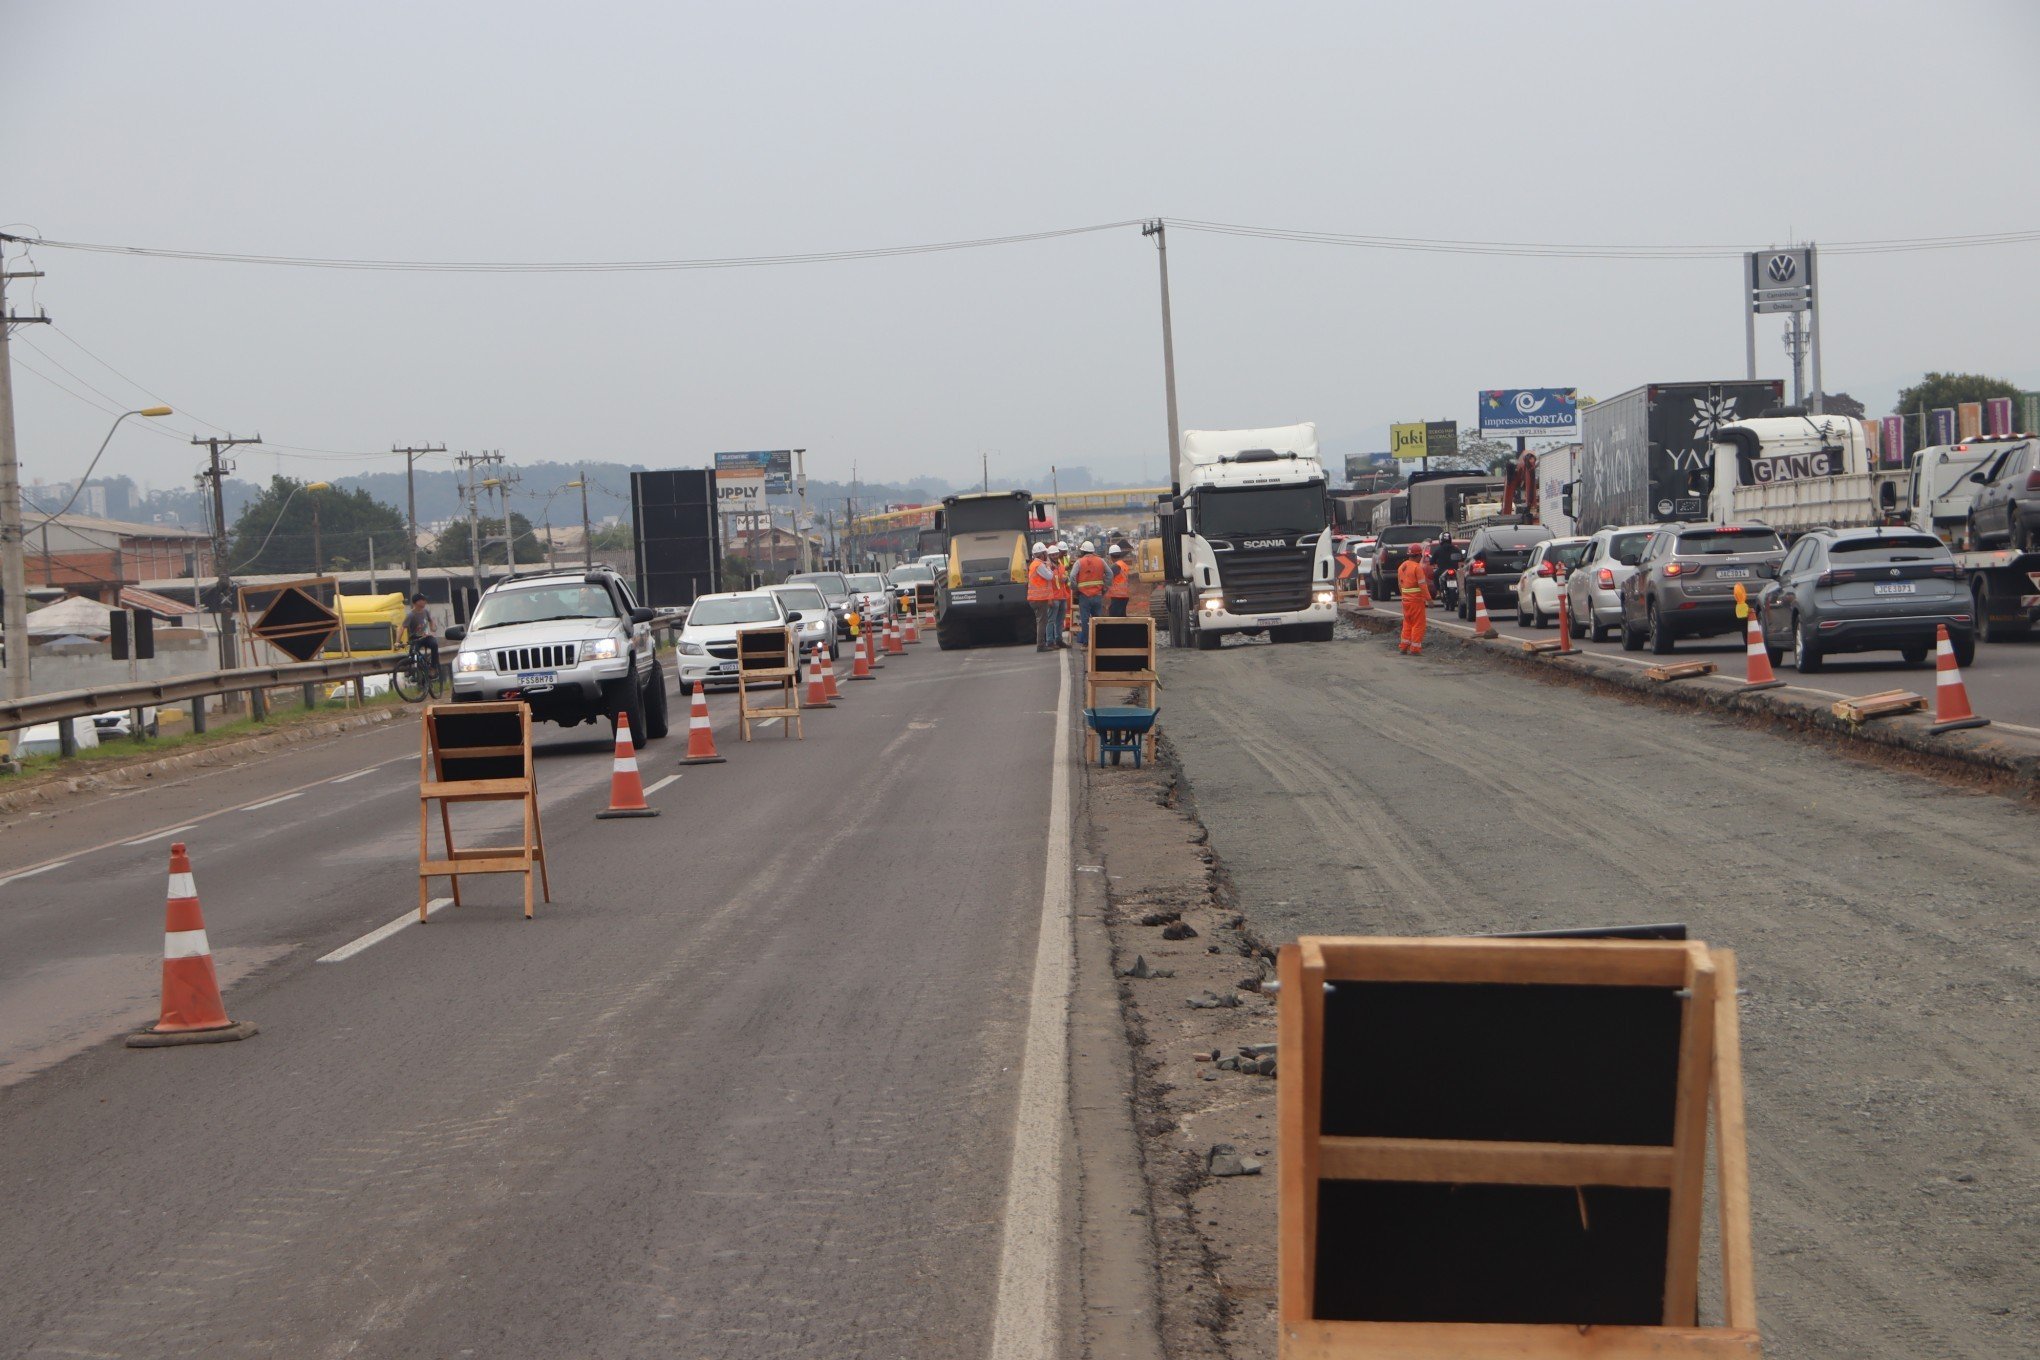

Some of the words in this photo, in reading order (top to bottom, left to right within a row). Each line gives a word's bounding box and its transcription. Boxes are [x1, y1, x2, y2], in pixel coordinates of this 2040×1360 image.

[1394, 430, 1425, 452] Jaki
[1754, 453, 1830, 482] GANG
[1243, 539, 1286, 549] SCANIA
